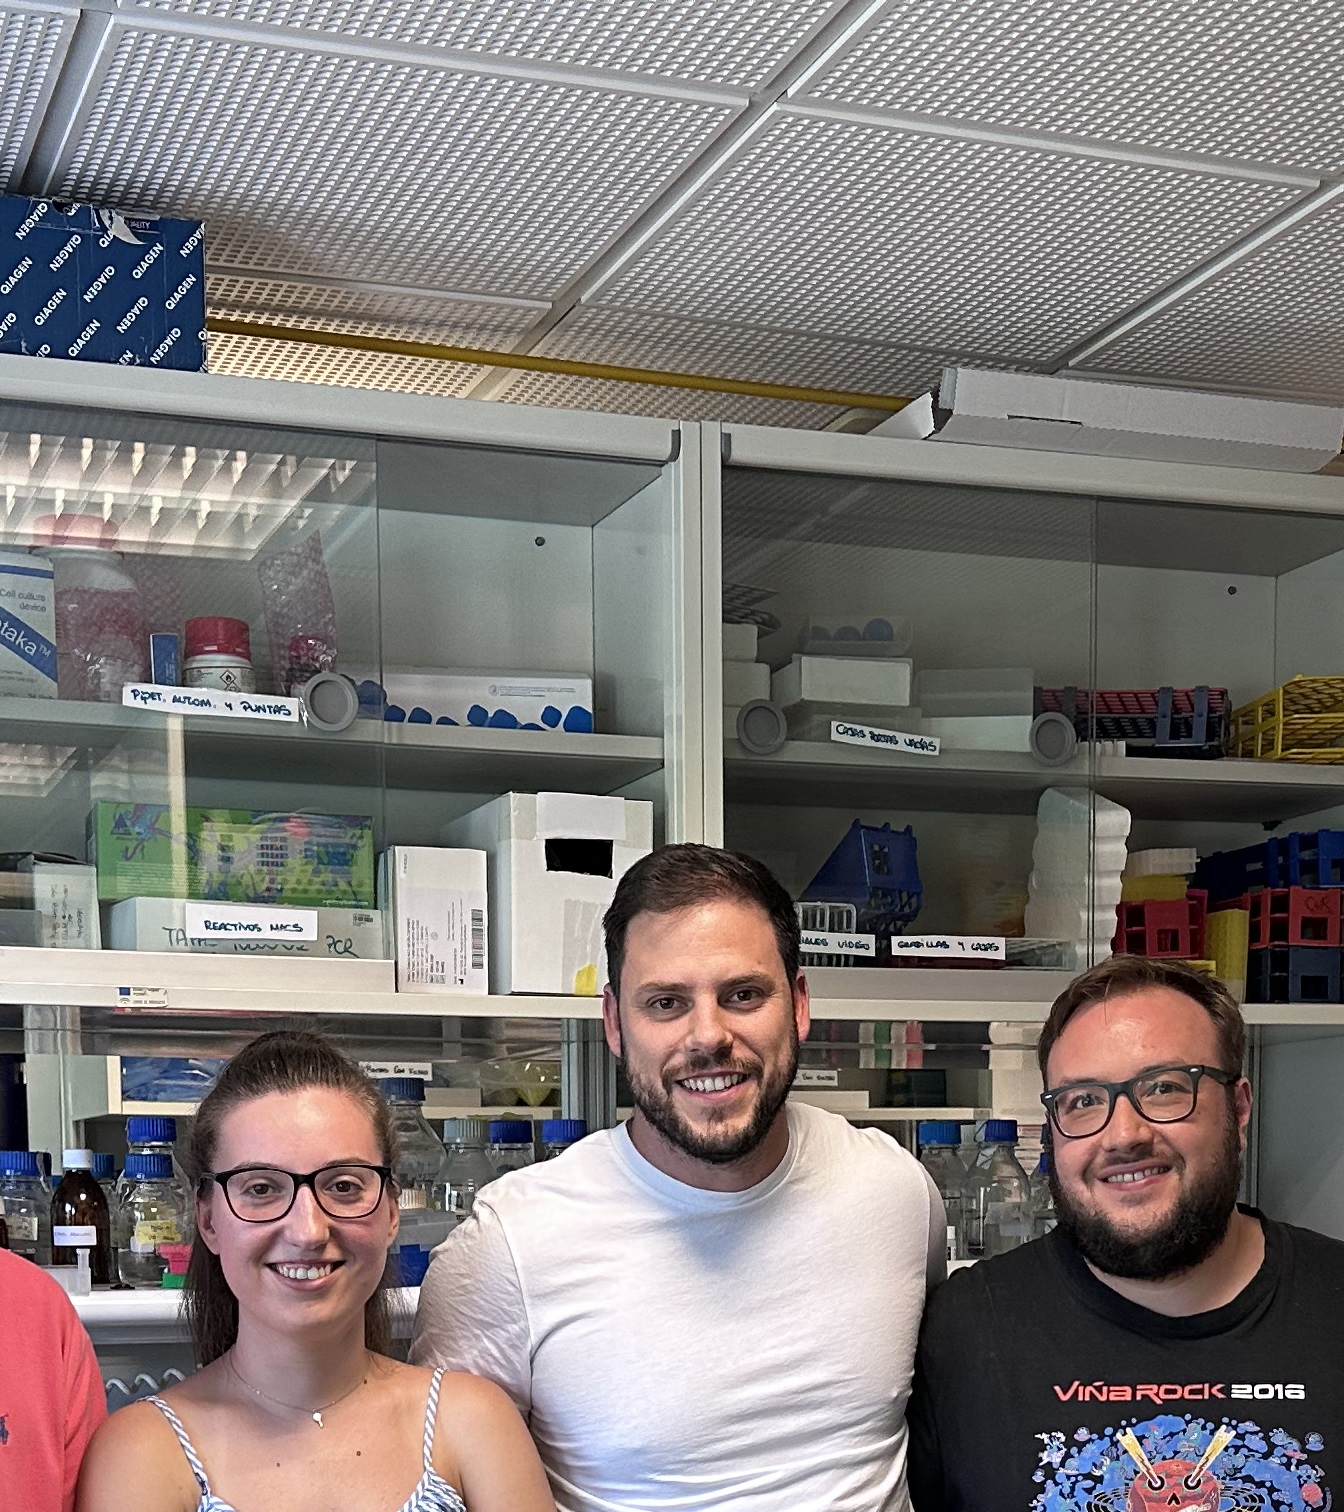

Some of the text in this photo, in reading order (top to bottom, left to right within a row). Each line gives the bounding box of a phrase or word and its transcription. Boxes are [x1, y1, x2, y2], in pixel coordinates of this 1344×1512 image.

[15, 202, 48, 240] QIAGEN
[49, 235, 81, 271] QIAGEN
[132, 243, 164, 279] QIAGEN
[0, 256, 33, 295] QIAGEN
[83, 266, 115, 302] QIAGEN
[166, 274, 196, 310] QIAGEN
[34, 288, 67, 325] QIAGEN
[116, 297, 148, 333] QIAGEN
[68, 319, 101, 357] QIAGEN
[150, 328, 181, 364] QIAGEN
[0, 588, 15, 597] Cell
[1231, 1383, 1305, 1399] 2016
